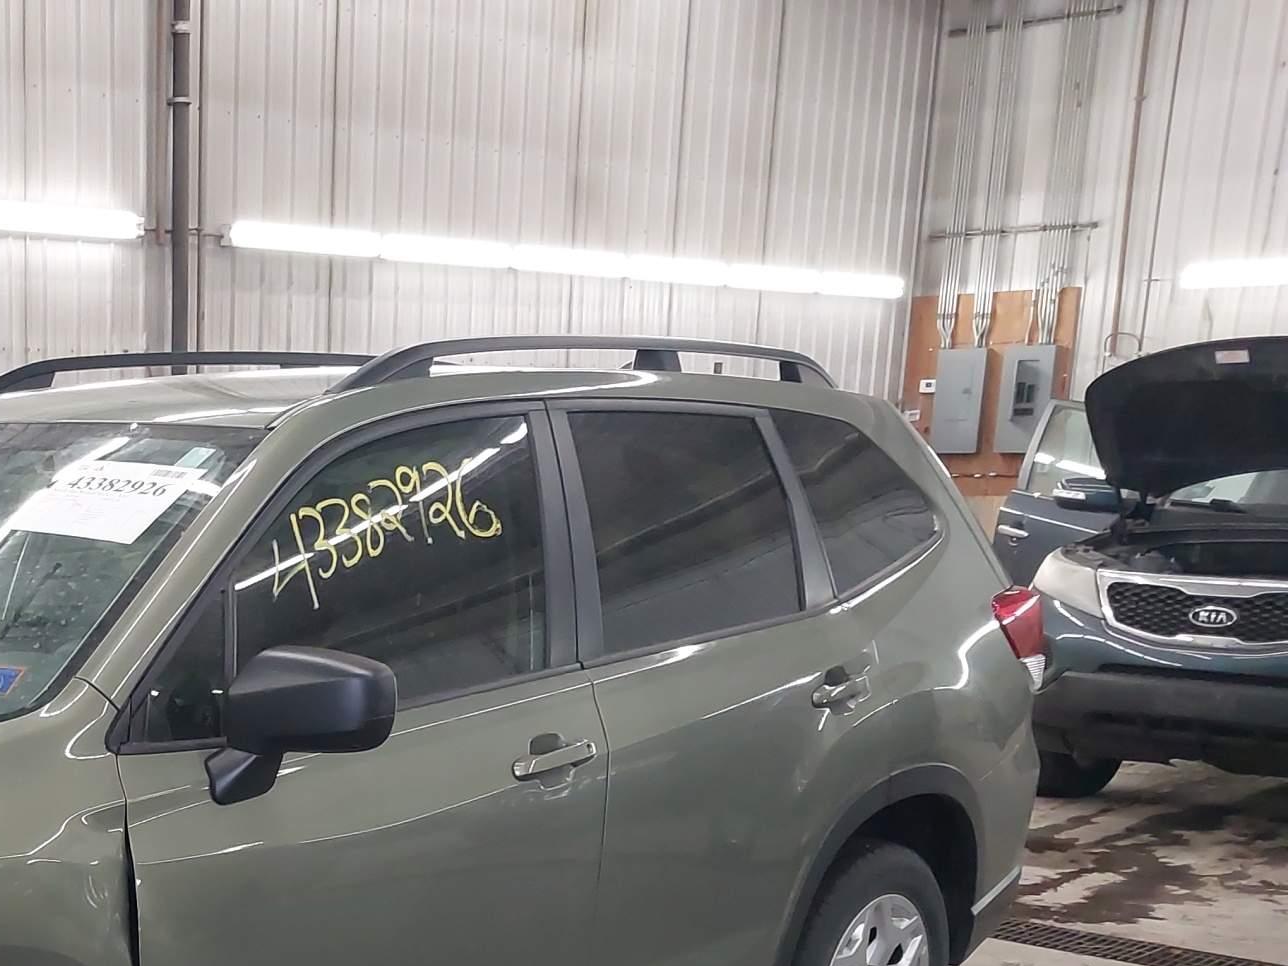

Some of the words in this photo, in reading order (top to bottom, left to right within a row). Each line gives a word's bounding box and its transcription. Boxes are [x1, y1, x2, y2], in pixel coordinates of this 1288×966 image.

[67, 474, 174, 497] 43382926
[273, 457, 503, 610] 43382926
[1198, 610, 1227, 624] KIA
